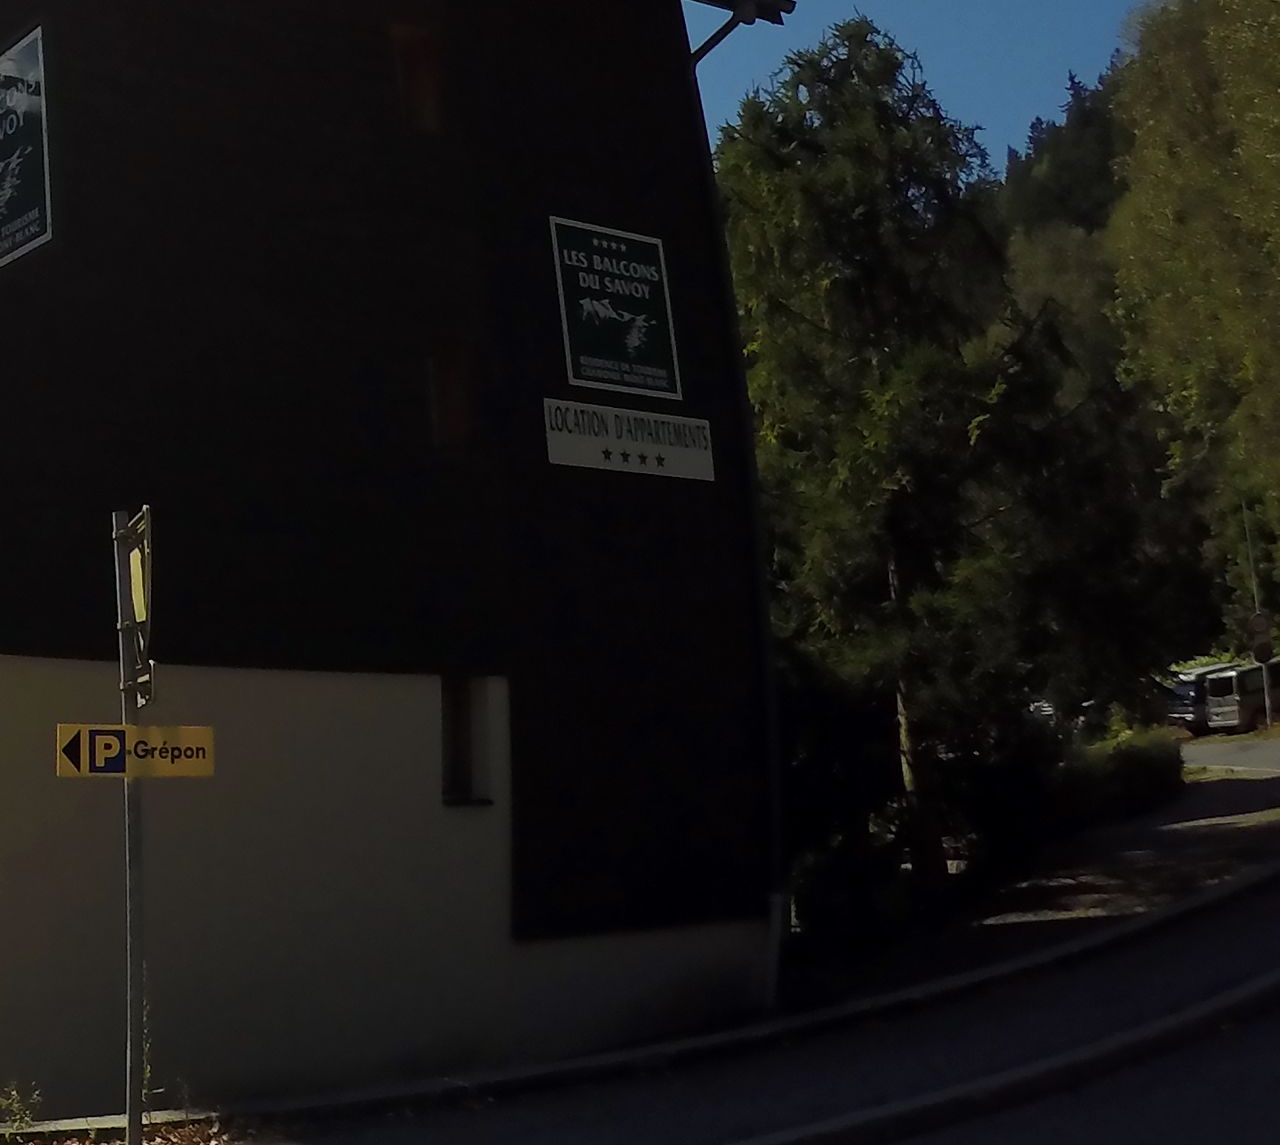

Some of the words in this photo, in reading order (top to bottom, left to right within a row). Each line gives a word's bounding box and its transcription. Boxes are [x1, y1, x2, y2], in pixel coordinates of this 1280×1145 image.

[563, 249, 588, 268] LES
[592, 255, 659, 281] BALCONS
[578, 272, 600, 290] DU
[604, 277, 650, 299] SAVOY
[548, 405, 609, 437] LOCATION
[615, 414, 709, 451] D'APPARTEMENTS
[95, 735, 121, 768] P
[134, 741, 206, 764] Grépon
